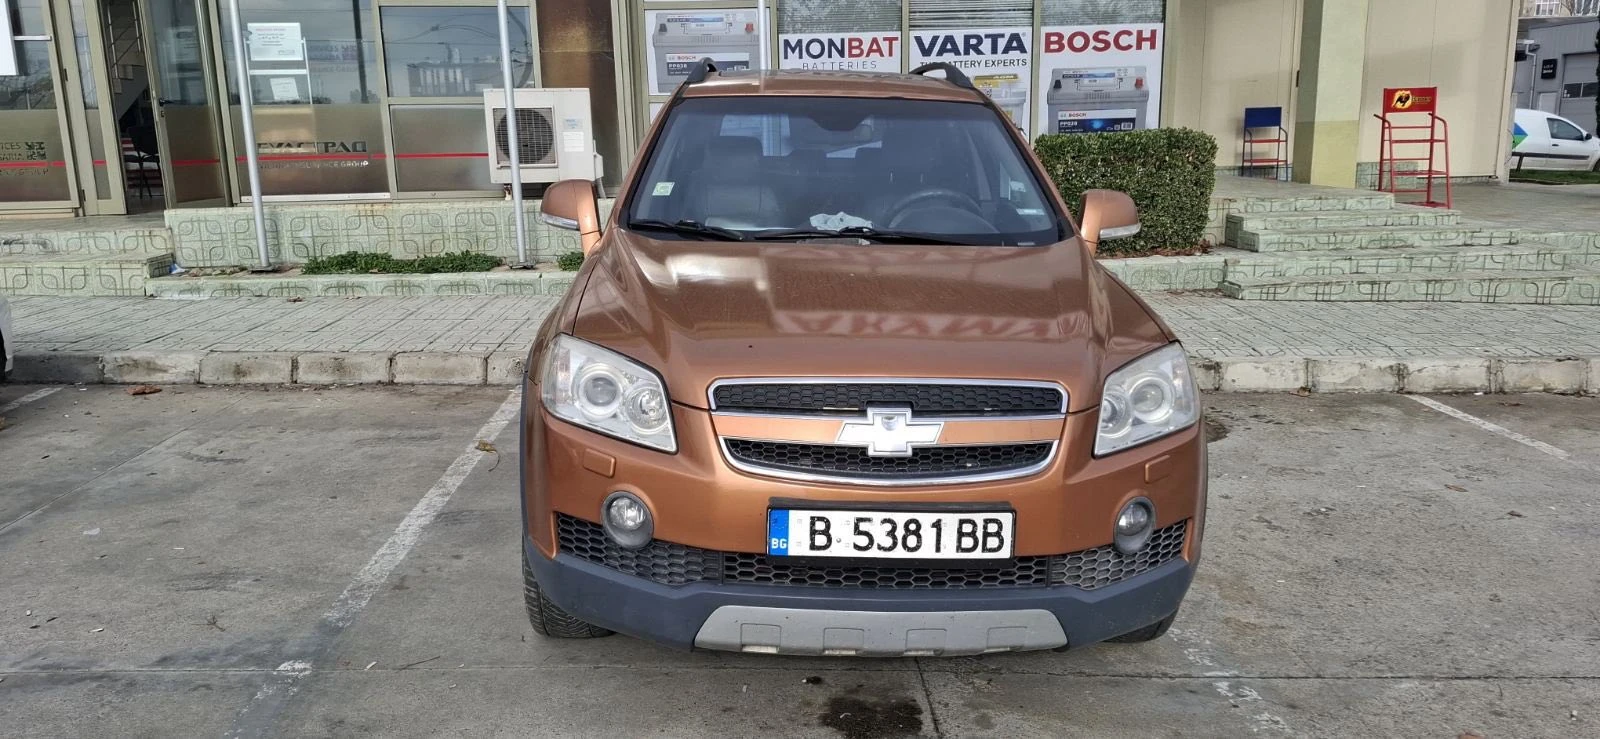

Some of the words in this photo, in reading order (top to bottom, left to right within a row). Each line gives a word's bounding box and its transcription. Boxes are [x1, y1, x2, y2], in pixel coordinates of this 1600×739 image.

[784, 37, 899, 60] MONBAT
[914, 33, 1027, 57] VARTA
[1044, 29, 1157, 53] BOSCH
[802, 60, 877, 70] BATTERIES
[947, 60, 982, 69] TTERY
[984, 59, 1027, 67] EXPERTS
[771, 540, 788, 549] BG
[809, 516, 833, 551] B
[853, 517, 942, 553] 5381
[956, 518, 1005, 553] BB
